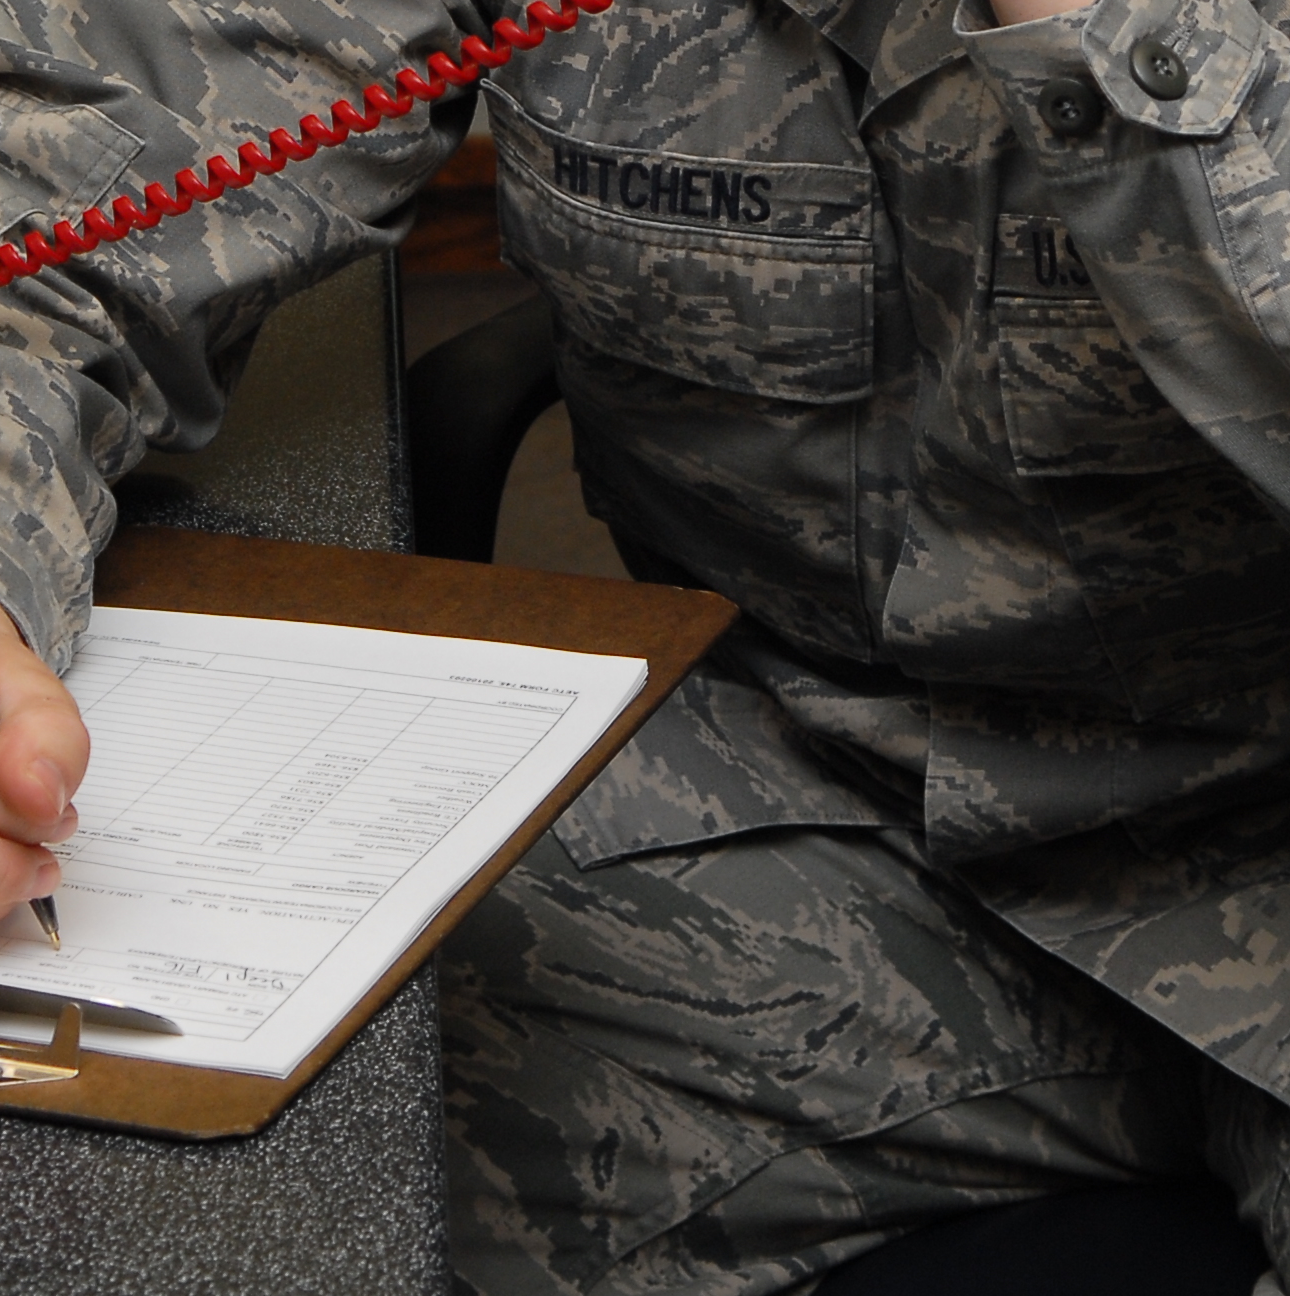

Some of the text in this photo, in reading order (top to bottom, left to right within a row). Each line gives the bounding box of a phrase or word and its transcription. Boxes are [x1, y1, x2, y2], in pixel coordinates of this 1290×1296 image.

[553, 145, 772, 222] HITCHENS
[411, 782, 454, 792] Recovery
[387, 797, 442, 809] Engineering
[435, 795, 474, 804] Weather
[396, 808, 441, 818] Readiness
[377, 815, 449, 828] Security Forces
[326, 819, 442, 837] Hospital/Medical Facility
[101, 833, 140, 841] RECORD
[357, 832, 411, 843] Department
[215, 841, 264, 850] TELEPHONE
[373, 844, 423, 854] Command
[175, 860, 215, 868] LOCATION
[106, 890, 144, 899] CABLE
[185, 889, 227, 898] DISTANCE
[324, 885, 380, 895] HAZARDOUS
[167, 897, 193, 905] UNK
[270, 969, 305, 978] NATURE
[160, 980, 192, 988] CRASH
[191, 985, 231, 994] PRIMARY
